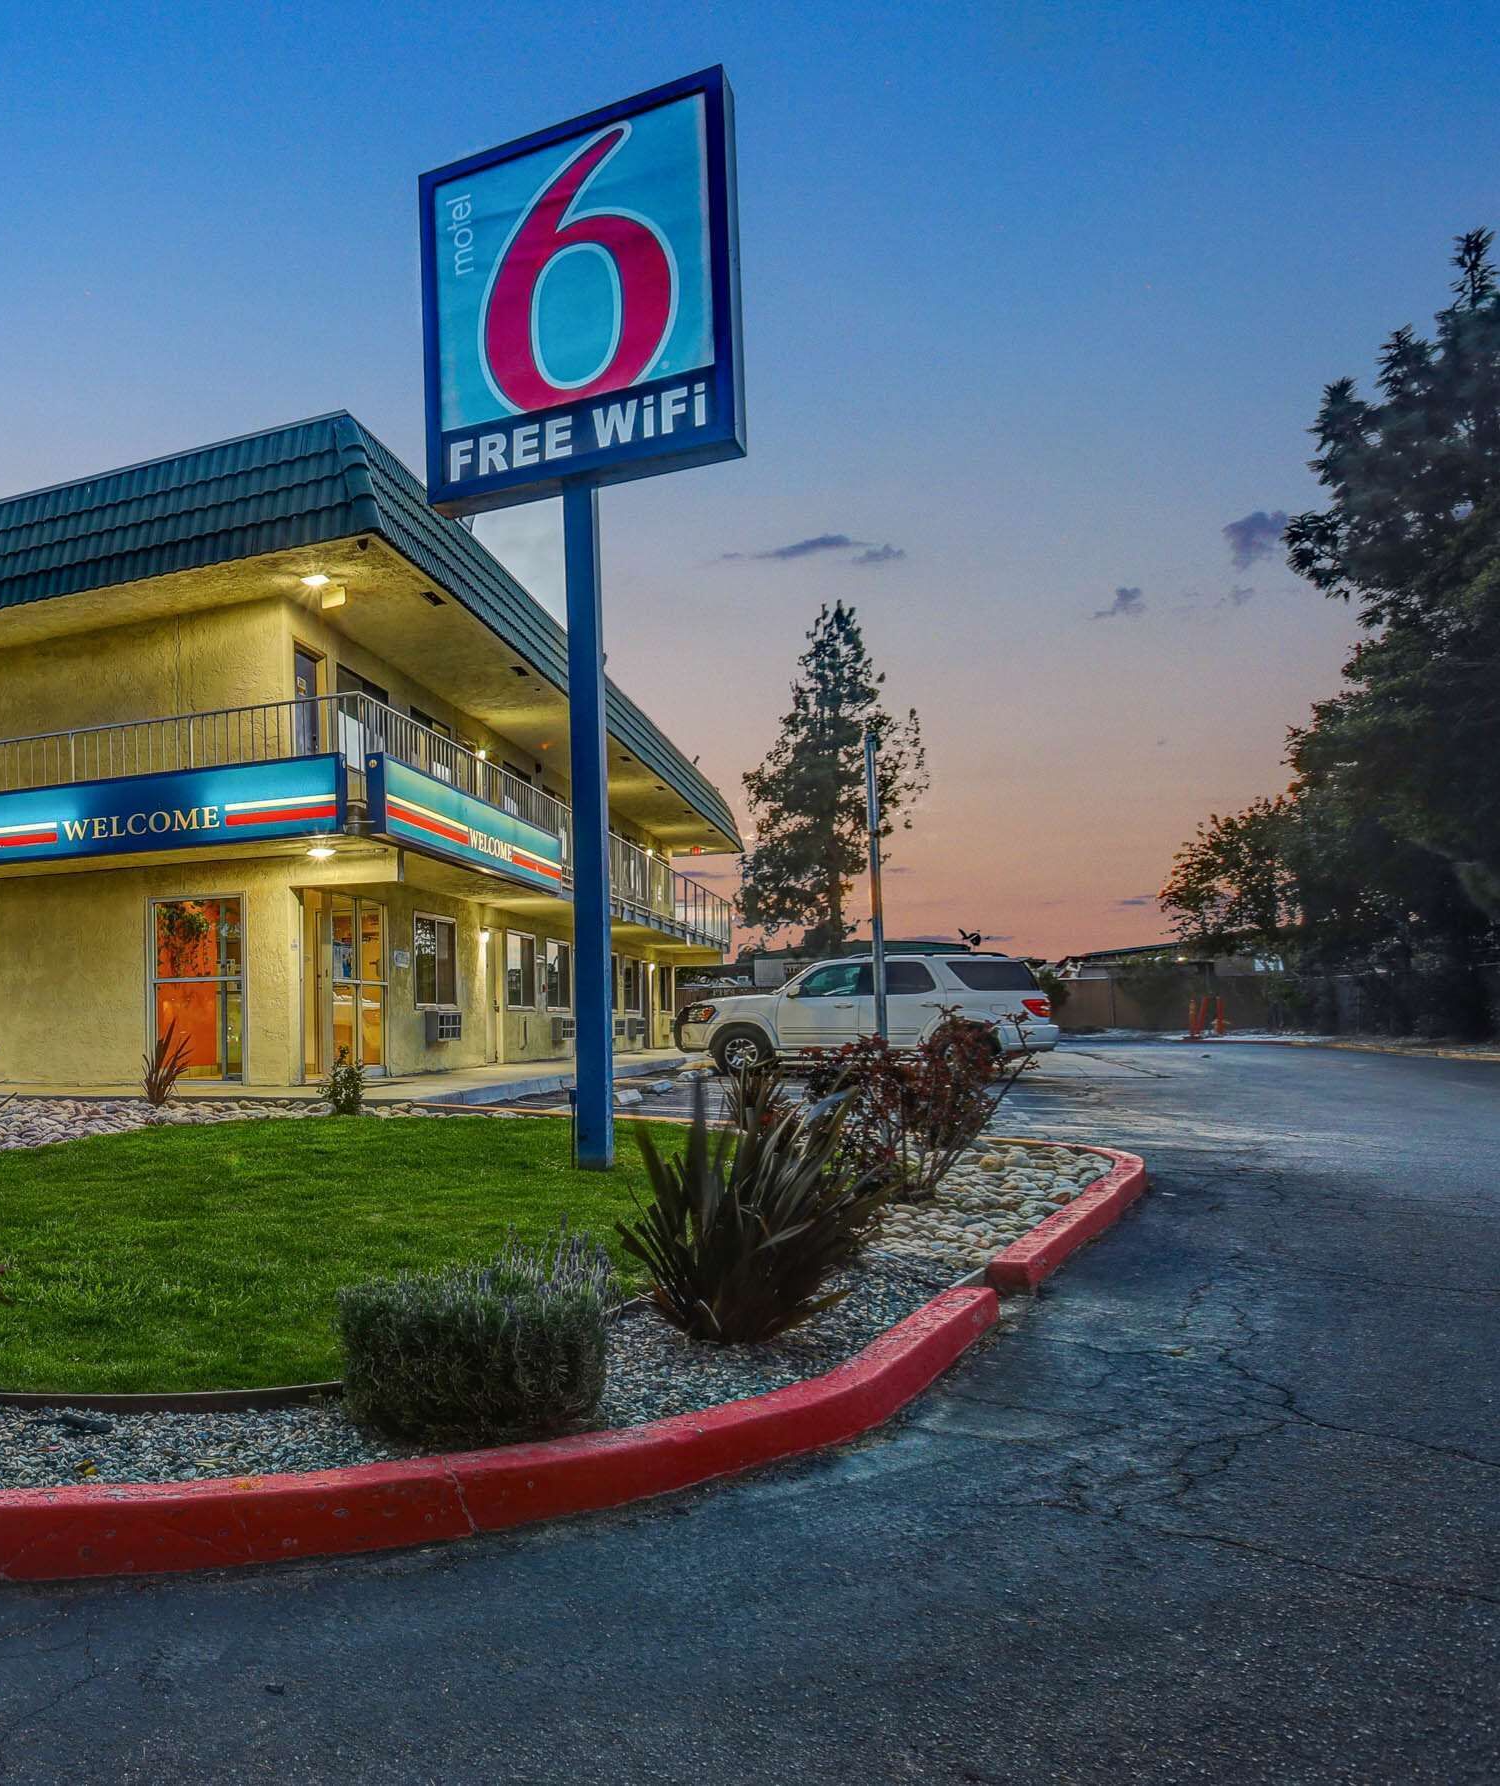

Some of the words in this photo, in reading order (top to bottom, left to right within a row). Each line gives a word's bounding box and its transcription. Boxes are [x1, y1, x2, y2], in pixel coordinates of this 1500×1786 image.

[446, 193, 474, 275] motel
[477, 120, 679, 414] 6
[450, 415, 573, 482] FREE
[592, 382, 706, 448] WiFi
[62, 805, 220, 841] WELCOME
[468, 827, 513, 862] WELCOME
